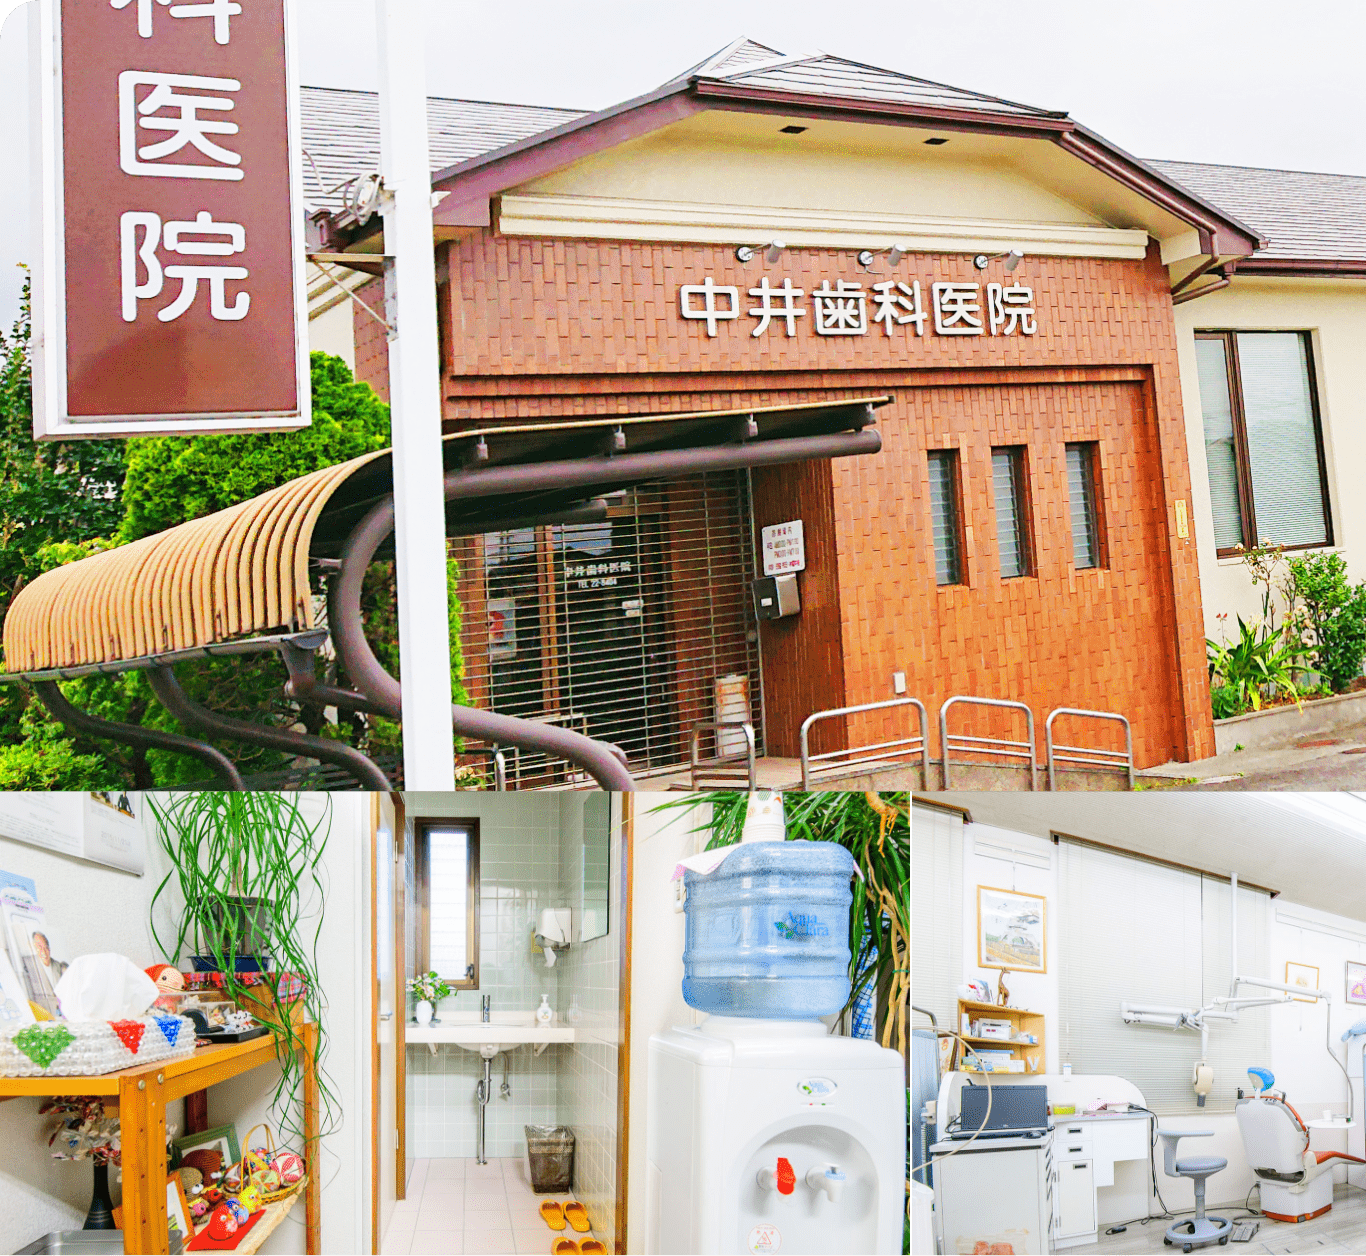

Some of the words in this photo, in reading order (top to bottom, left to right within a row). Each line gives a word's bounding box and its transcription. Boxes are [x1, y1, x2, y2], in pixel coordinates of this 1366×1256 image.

[679, 276, 1038, 337] 中井歯科医院
